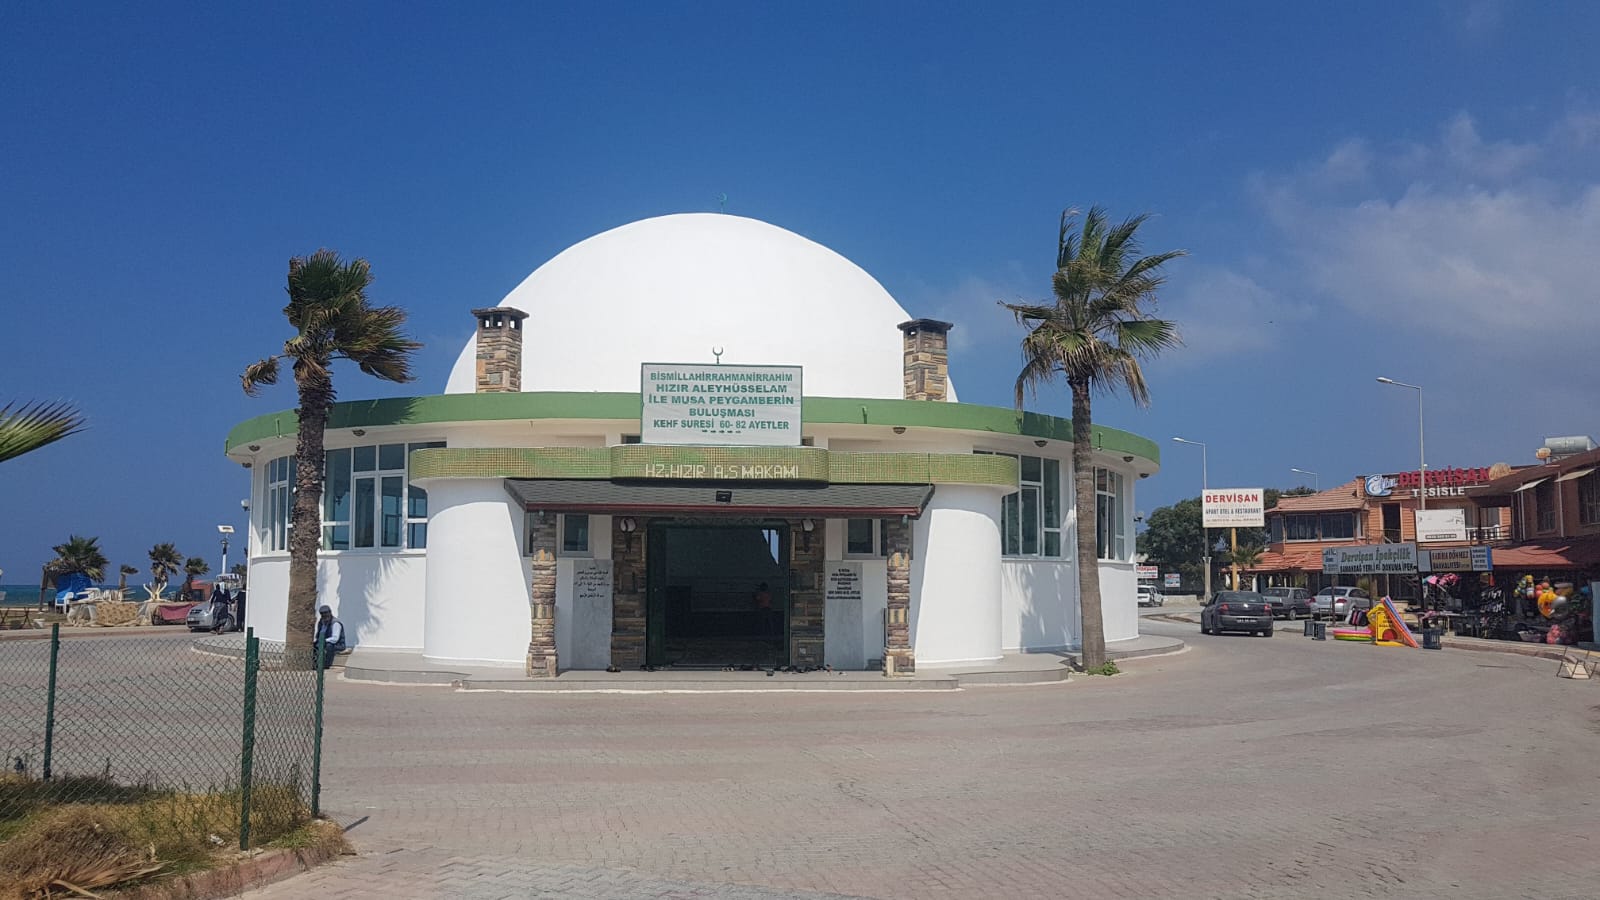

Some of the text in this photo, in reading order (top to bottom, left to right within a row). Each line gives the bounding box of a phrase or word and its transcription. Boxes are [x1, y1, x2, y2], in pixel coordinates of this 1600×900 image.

[650, 372, 793, 382] BİSMİLLAHİRRAHMANİRRAHİM
[656, 382, 787, 393] HIZIR ALEYHÜSSELAM
[648, 394, 794, 405] İLE MUSA PEYGAMBERİN
[689, 408, 755, 418] BULUŞMASI
[653, 419, 678, 428] KEHF
[681, 418, 714, 428] SURESİ
[748, 420, 790, 430] AYETLER
[741, 465, 799, 479] MAKAMI
